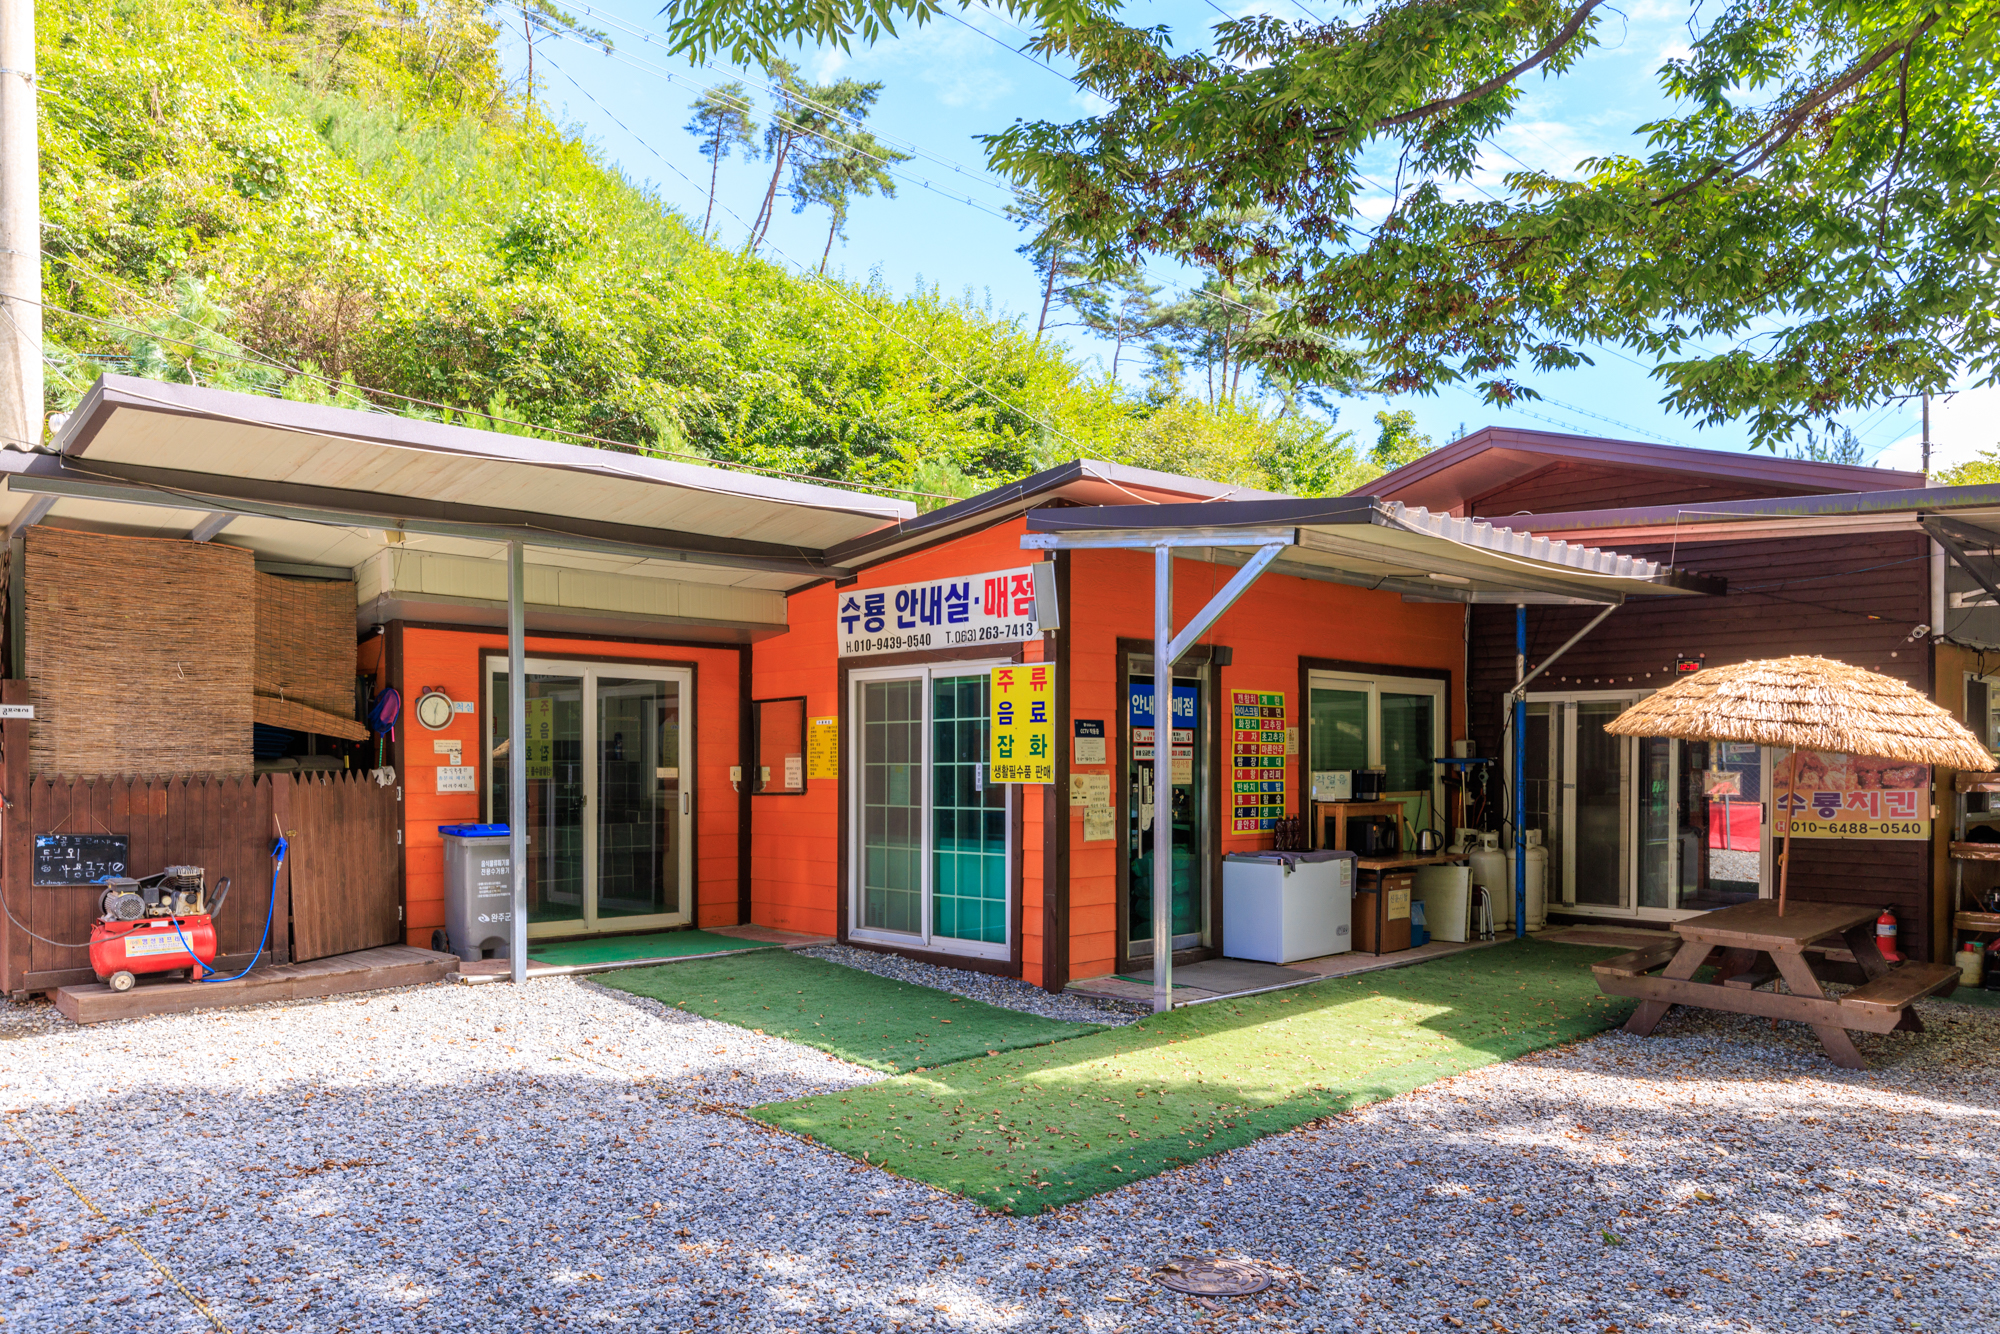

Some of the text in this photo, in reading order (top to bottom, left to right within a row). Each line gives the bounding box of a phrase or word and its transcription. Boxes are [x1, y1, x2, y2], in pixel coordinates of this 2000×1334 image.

[841, 593, 885, 634] 수룡
[846, 633, 931, 652] H.010-9439-0540
[455, 702, 473, 712] 척실
[1173, 697, 1193, 716] 매점
[1235, 706, 1258, 716] 아이스크림
[1239, 720, 1256, 729] 화장지
[1264, 720, 1281, 730] 고추장
[1262, 732, 1284, 742] 초고추장
[1262, 745, 1283, 754] 마른안주
[994, 764, 1051, 779] 생활필수품 판매
[1263, 770, 1280, 779] 슬리퍼
[1237, 783, 1255, 792] 반바지
[1792, 822, 1921, 835] 010-6488-0540
[491, 912, 511, 922] 완주군
